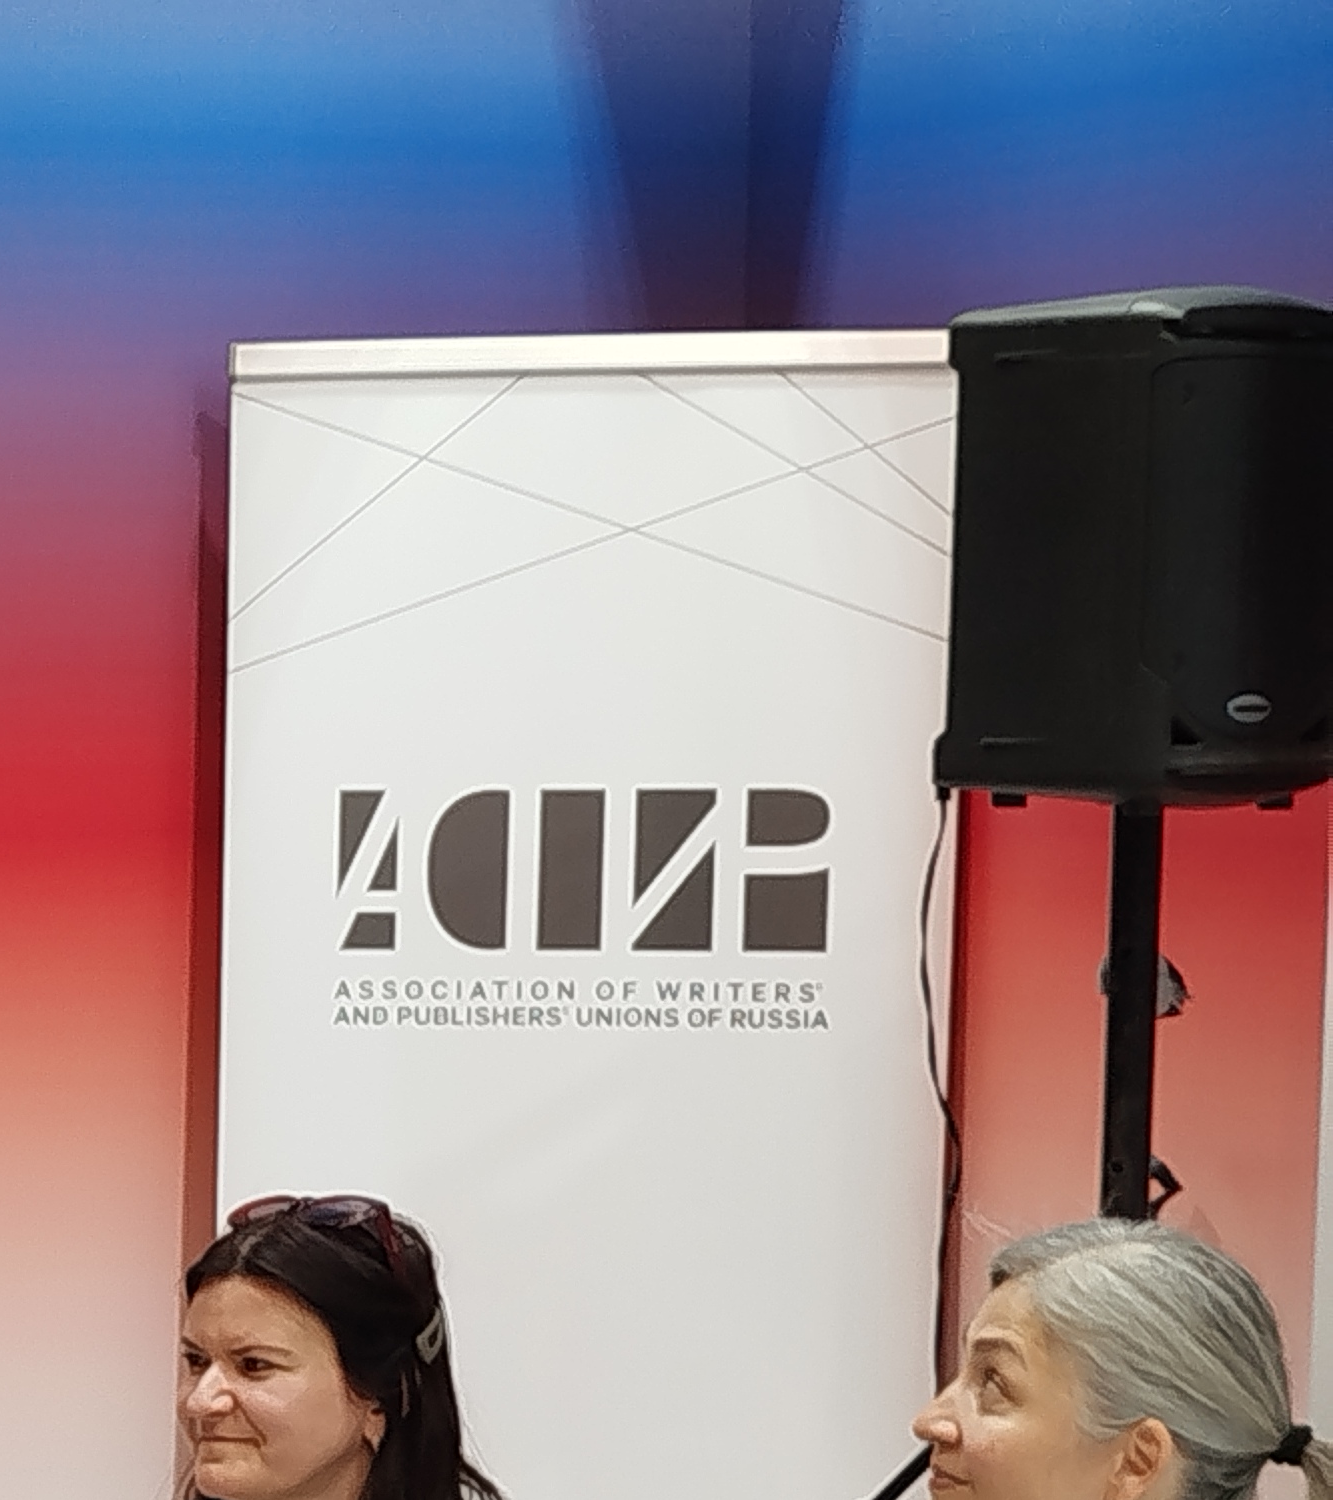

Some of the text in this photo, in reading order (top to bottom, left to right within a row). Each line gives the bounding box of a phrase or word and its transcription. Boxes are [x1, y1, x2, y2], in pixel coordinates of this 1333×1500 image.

[334, 979, 576, 1001] ASSOCIATION
[595, 980, 638, 1002] OF
[334, 1006, 388, 1026] AND
[576, 1006, 680, 1028] UNIONS
[687, 1007, 722, 1028] OF
[729, 1008, 829, 1030] RUSSIA
